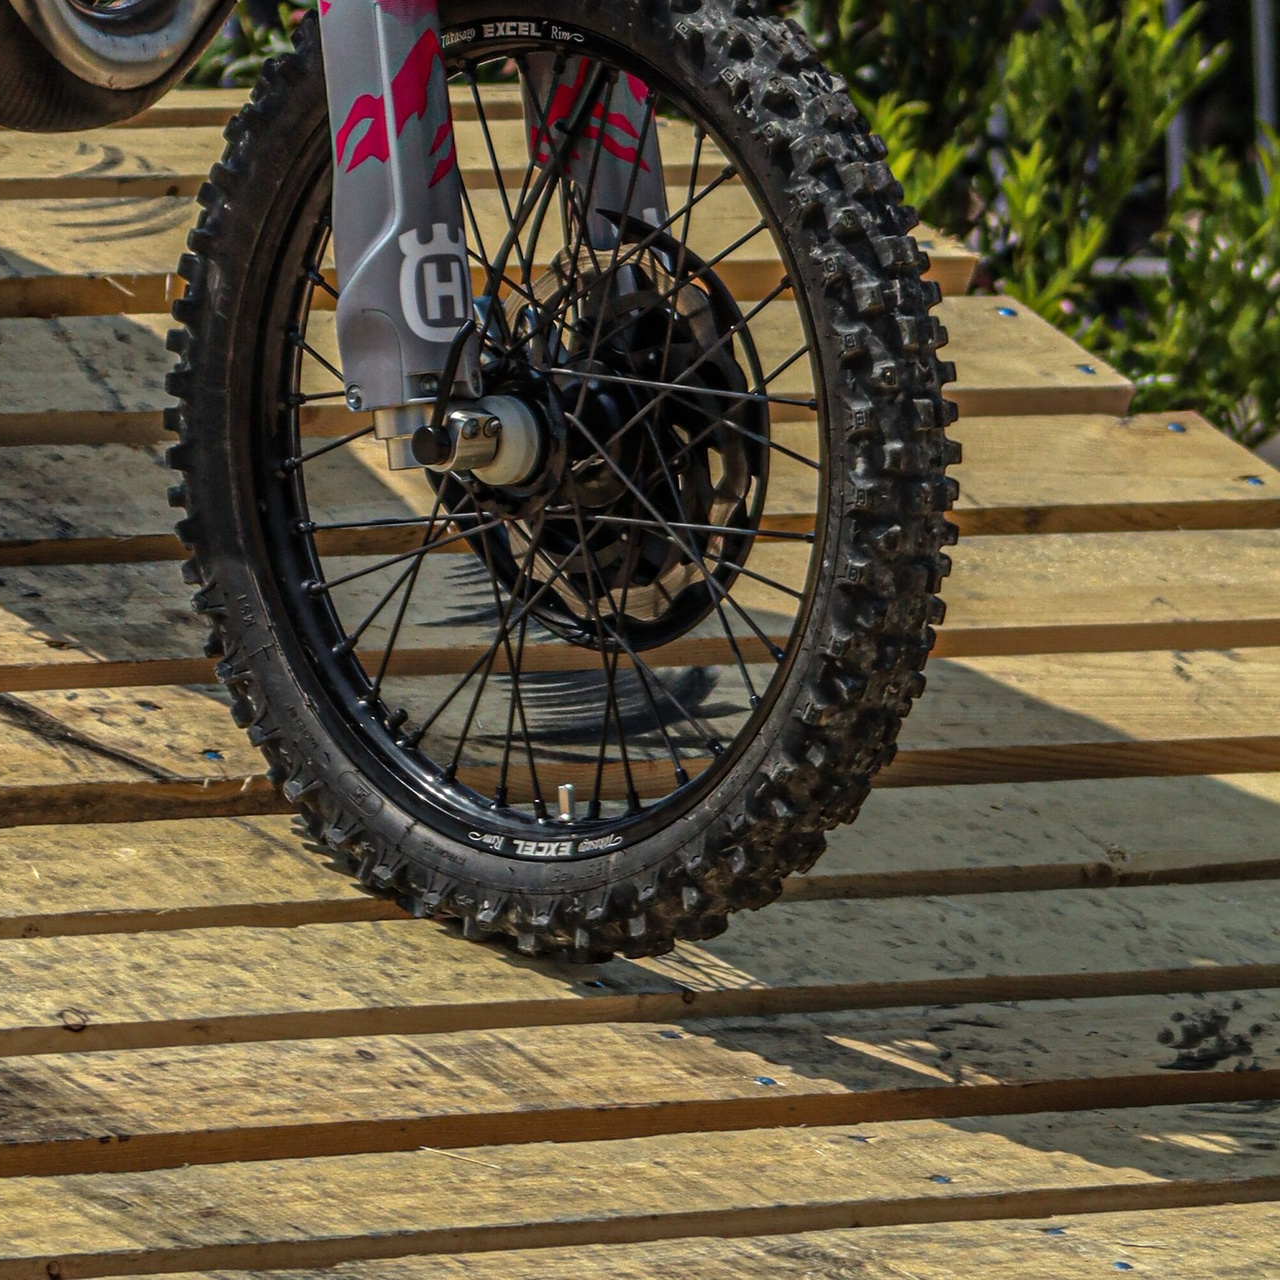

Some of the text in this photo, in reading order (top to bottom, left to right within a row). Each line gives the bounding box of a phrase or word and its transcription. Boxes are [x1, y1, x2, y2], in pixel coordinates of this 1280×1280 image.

[441, 21, 584, 48] Takasago EXCEL Rim
[513, 839, 573, 857] EXCEL
